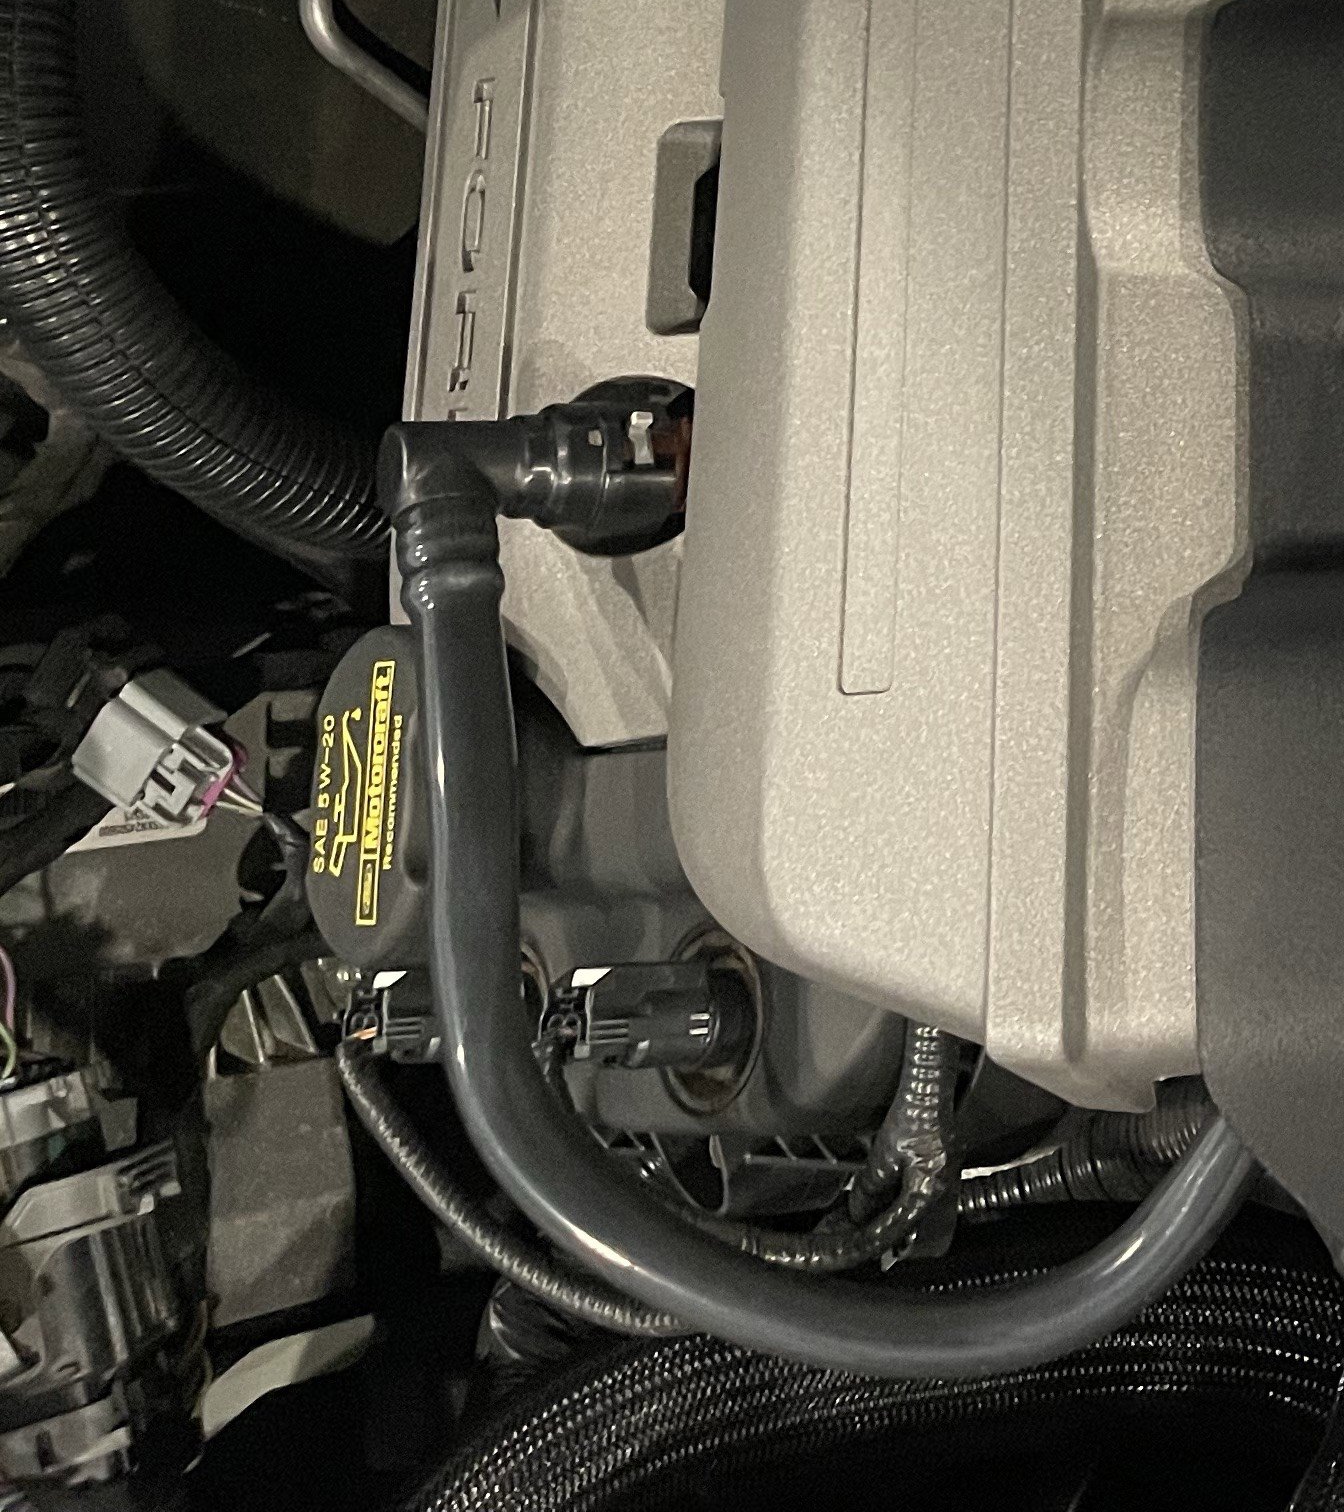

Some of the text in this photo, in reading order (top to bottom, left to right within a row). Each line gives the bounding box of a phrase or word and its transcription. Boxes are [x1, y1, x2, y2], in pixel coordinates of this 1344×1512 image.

[448, 76, 497, 420] FOR
[313, 714, 335, 874] SAE 5W-20
[363, 667, 392, 850] Motorcraft
[382, 714, 403, 870] Recommended
